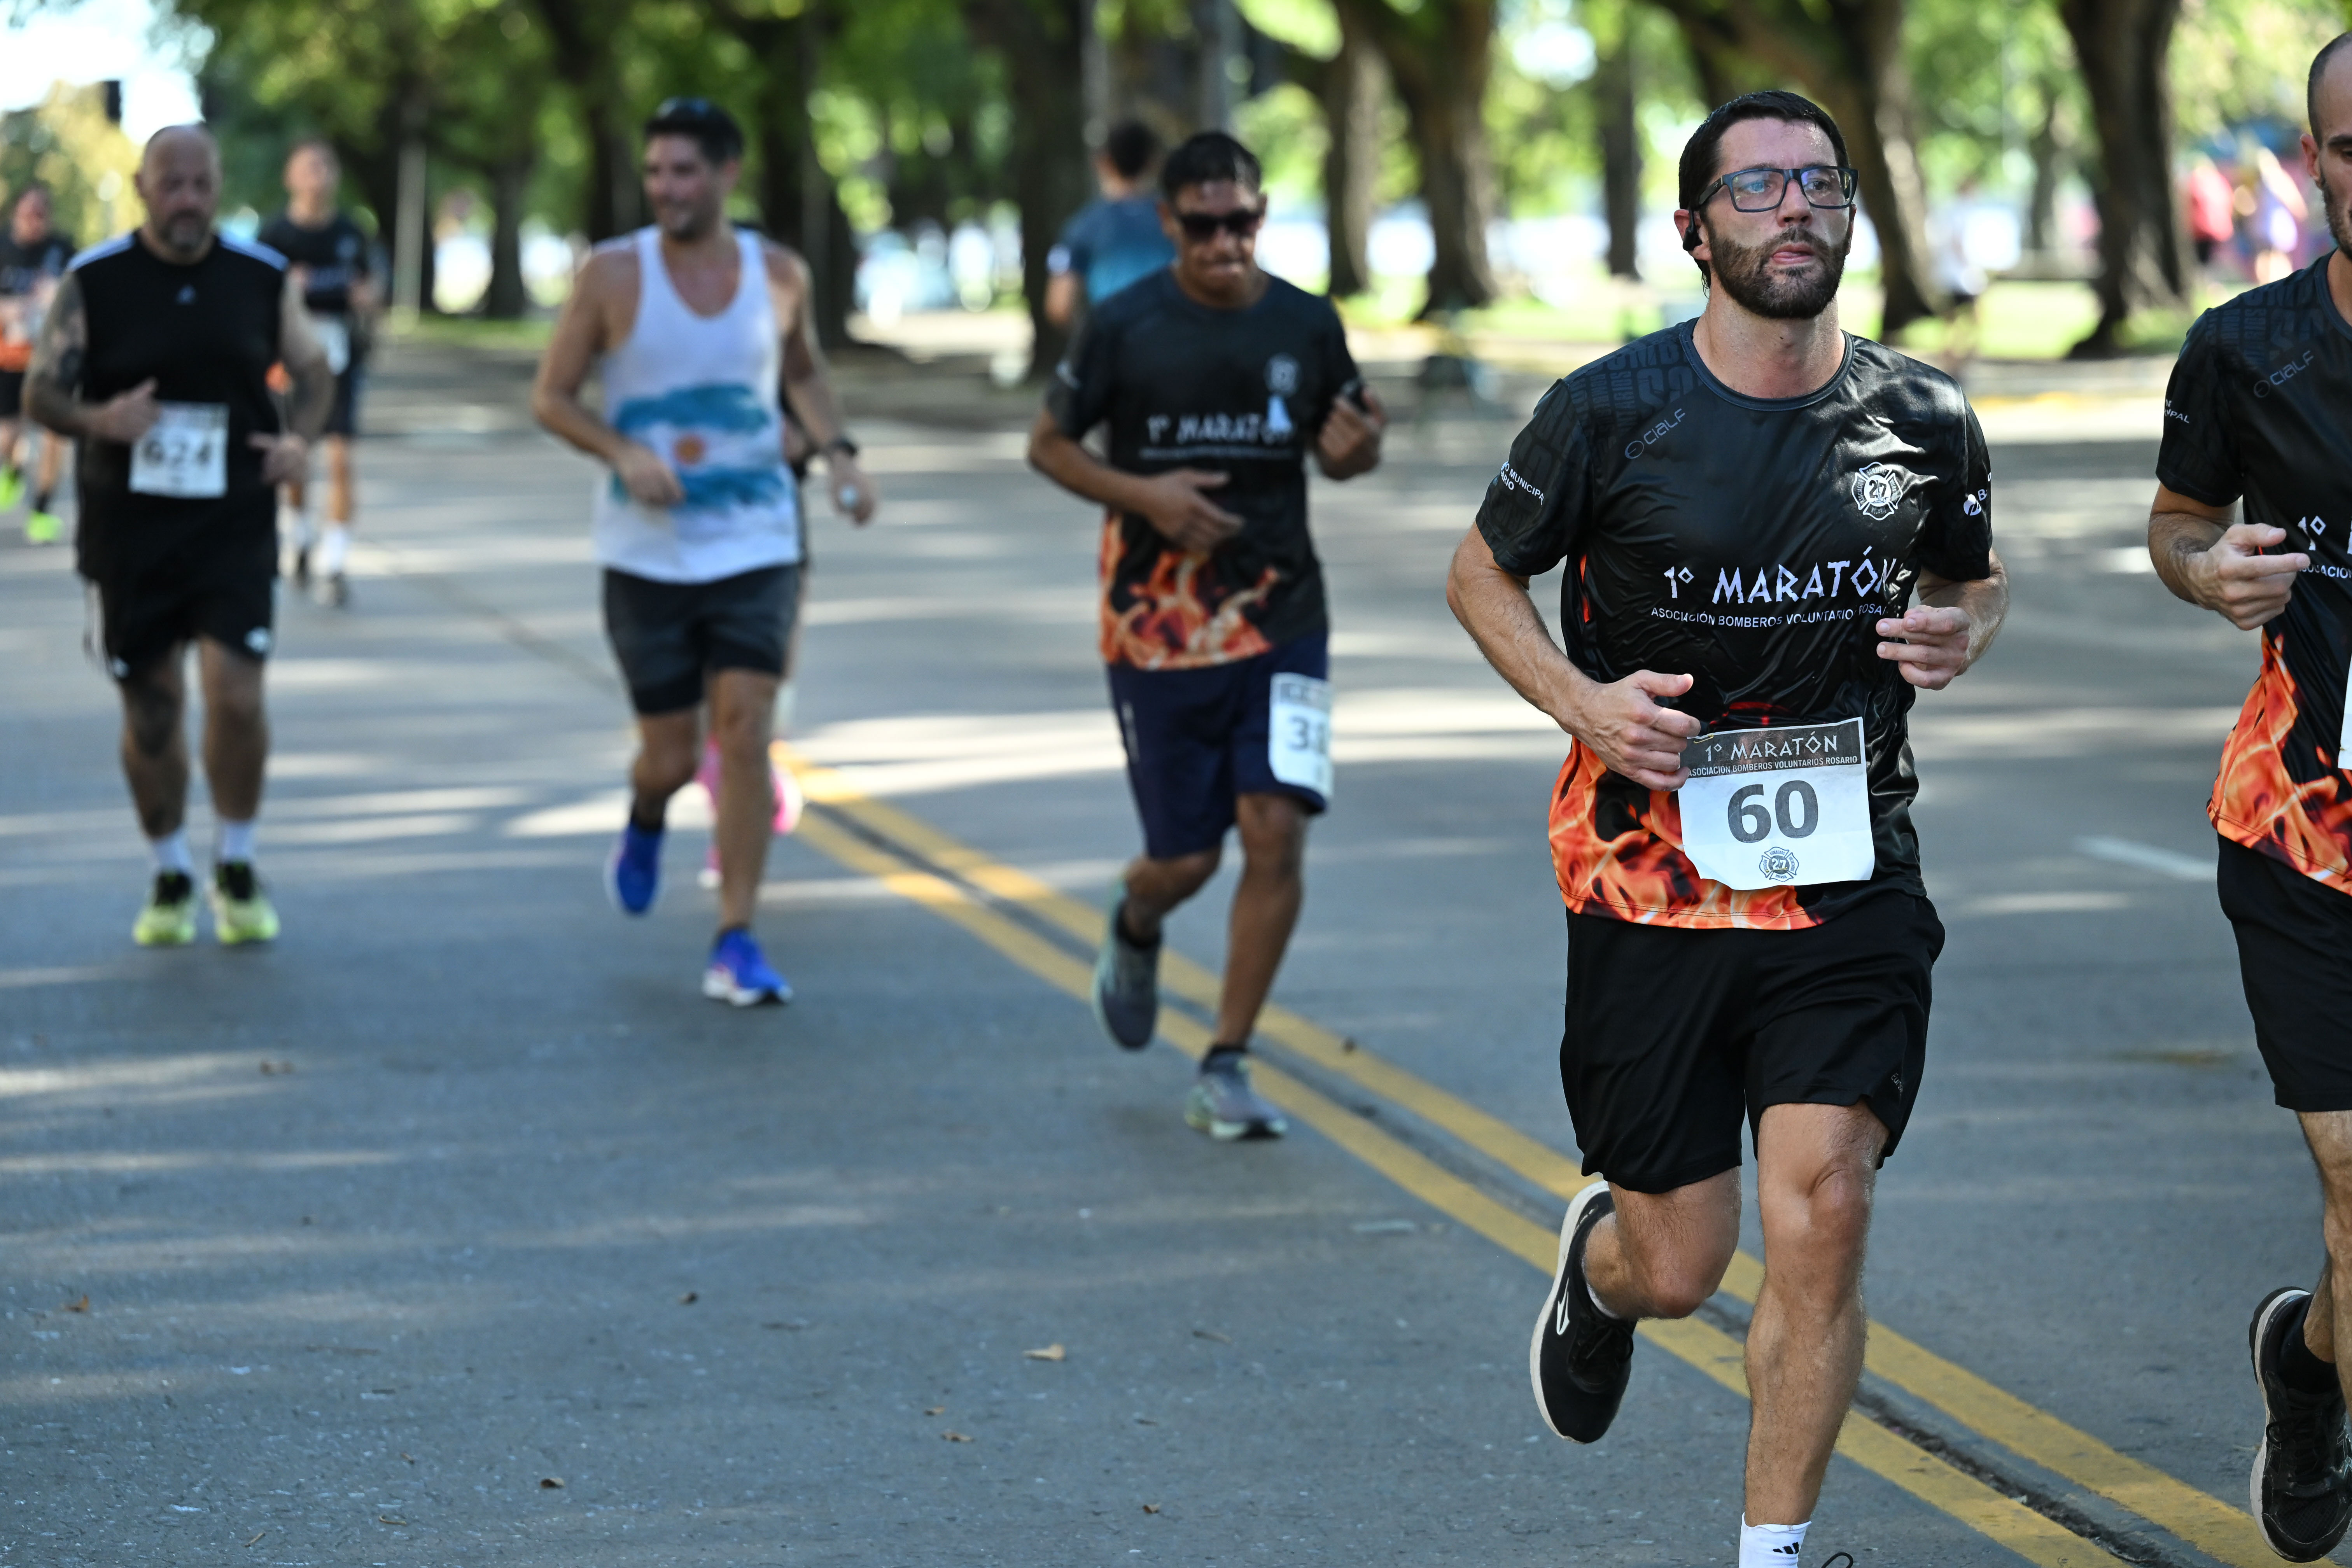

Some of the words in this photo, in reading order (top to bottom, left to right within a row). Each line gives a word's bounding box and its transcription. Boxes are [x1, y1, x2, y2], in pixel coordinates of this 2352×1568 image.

[1869, 480, 1887, 498] 27
[1718, 615, 1783, 627] BOMBEROS
[1731, 731, 1837, 761] MARATÓN
[1732, 762, 1772, 772] BOMBEROS
[1774, 758, 1824, 769] VOLUNTARIOS
[1826, 755, 1858, 765] ROSARIO
[1727, 780, 1819, 844] 60
[1771, 858, 1787, 870] 27
